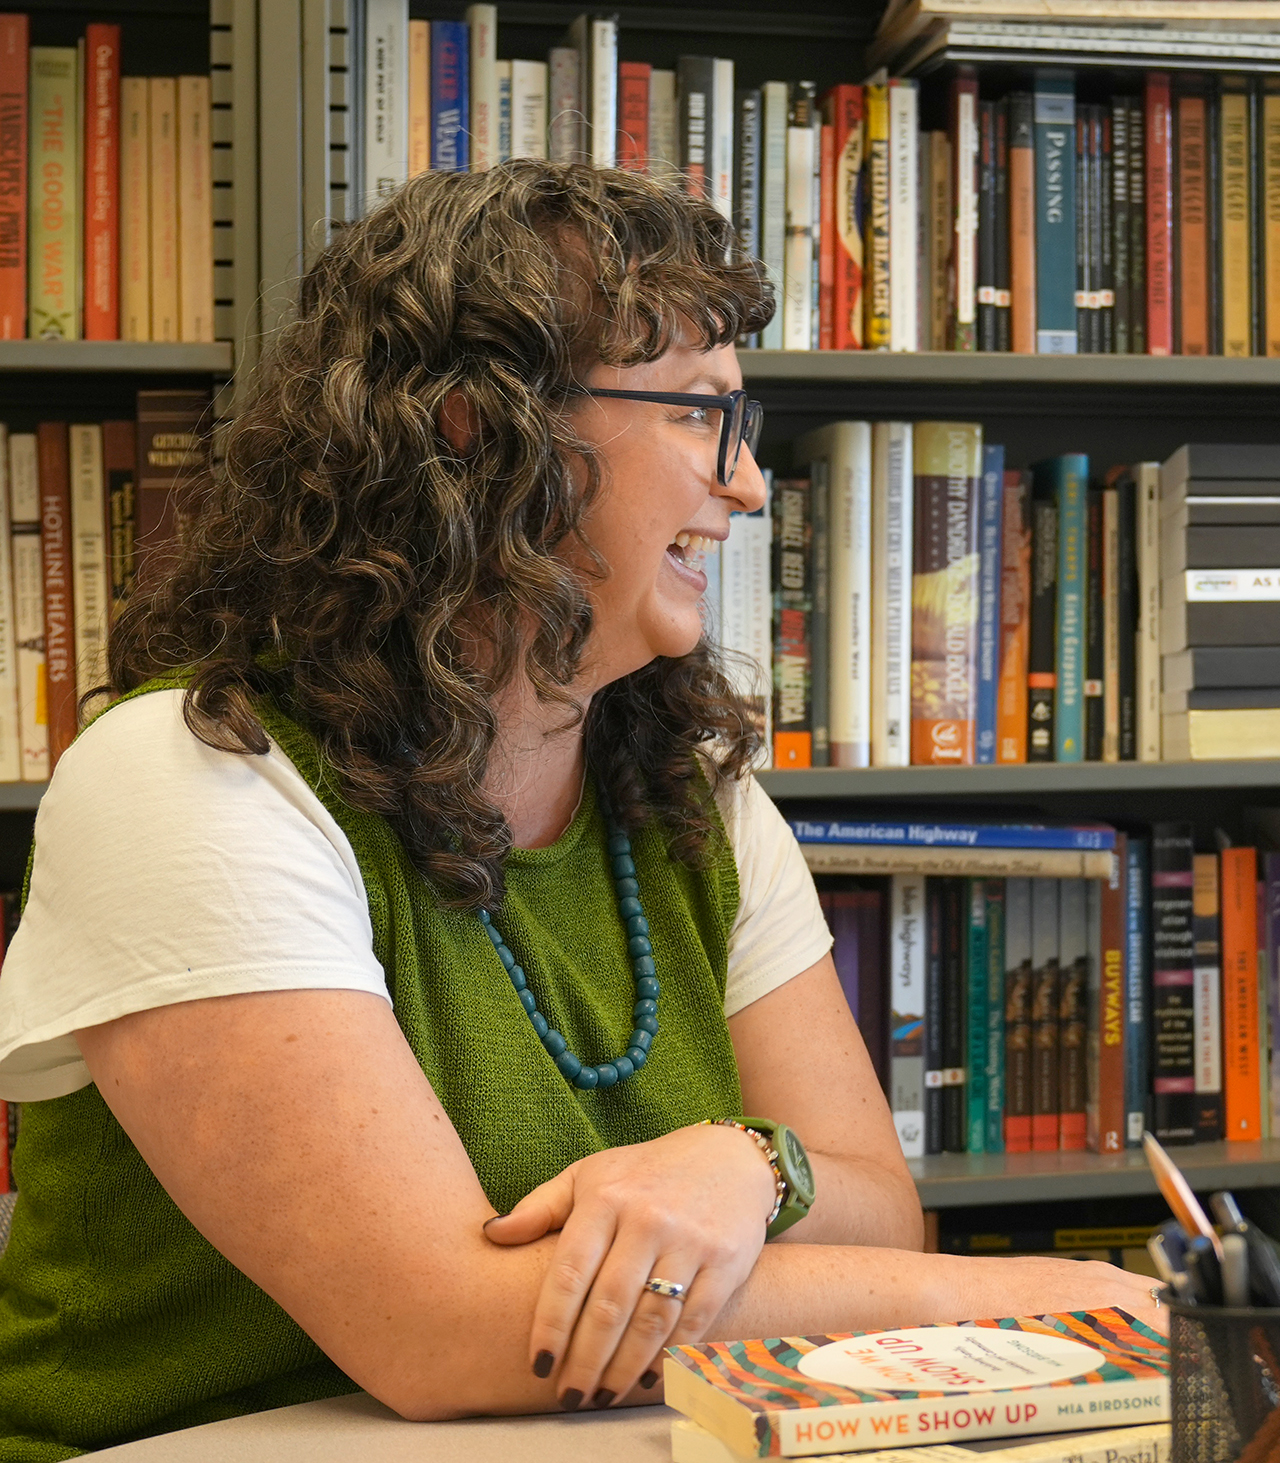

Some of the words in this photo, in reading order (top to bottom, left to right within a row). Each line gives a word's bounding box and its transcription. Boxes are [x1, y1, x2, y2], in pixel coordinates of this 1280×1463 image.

[741, 111, 756, 185] MICHAEL
[899, 110, 909, 151] BLACK
[41, 163, 64, 231] GOOD
[872, 141, 888, 229] FRIDAY
[899, 156, 909, 204] WOMAN
[1045, 131, 1067, 223] PASSING
[741, 188, 756, 225] ERIC
[872, 235, 888, 315] BLACK
[946, 430, 967, 499] DOROTHY
[44, 495, 65, 588] HOTLINE
[946, 501, 967, 586] DANDRIDGE
[781, 551, 804, 590] REED
[1252, 577, 1271, 587] AS
[47, 593, 67, 683] HEALERS
[946, 593, 967, 653] DONALD
[946, 655, 967, 702] BOGLE
[1061, 636, 1079, 705] Gazpacho
[795, 822, 823, 838] The
[828, 824, 905, 840] American
[908, 826, 978, 845] Highway
[901, 886, 917, 915] blue
[898, 919, 917, 987] highways
[1238, 951, 1248, 972] THE
[1104, 950, 1122, 1045] BUYWAYS
[1129, 1000, 1142, 1022] CAR
[1202, 974, 1210, 1027] SOMETHING
[1238, 978, 1248, 1039] AMERICAN
[1202, 1032, 1210, 1041] IN
[1202, 1047, 1210, 1063] THE
[1202, 1067, 1210, 1085] SOIL
[1238, 1045, 1248, 1076] WEST
[843, 1348, 884, 1364] WE
[876, 1338, 923, 1354] UP
[866, 1366, 925, 1384] HOW
[900, 1358, 986, 1385] SHOW
[796, 1418, 861, 1443] HOW
[870, 1414, 910, 1435] WE
[918, 1405, 996, 1432] SHOW
[1005, 1403, 1038, 1424] UP
[1057, 1403, 1084, 1416] MIA
